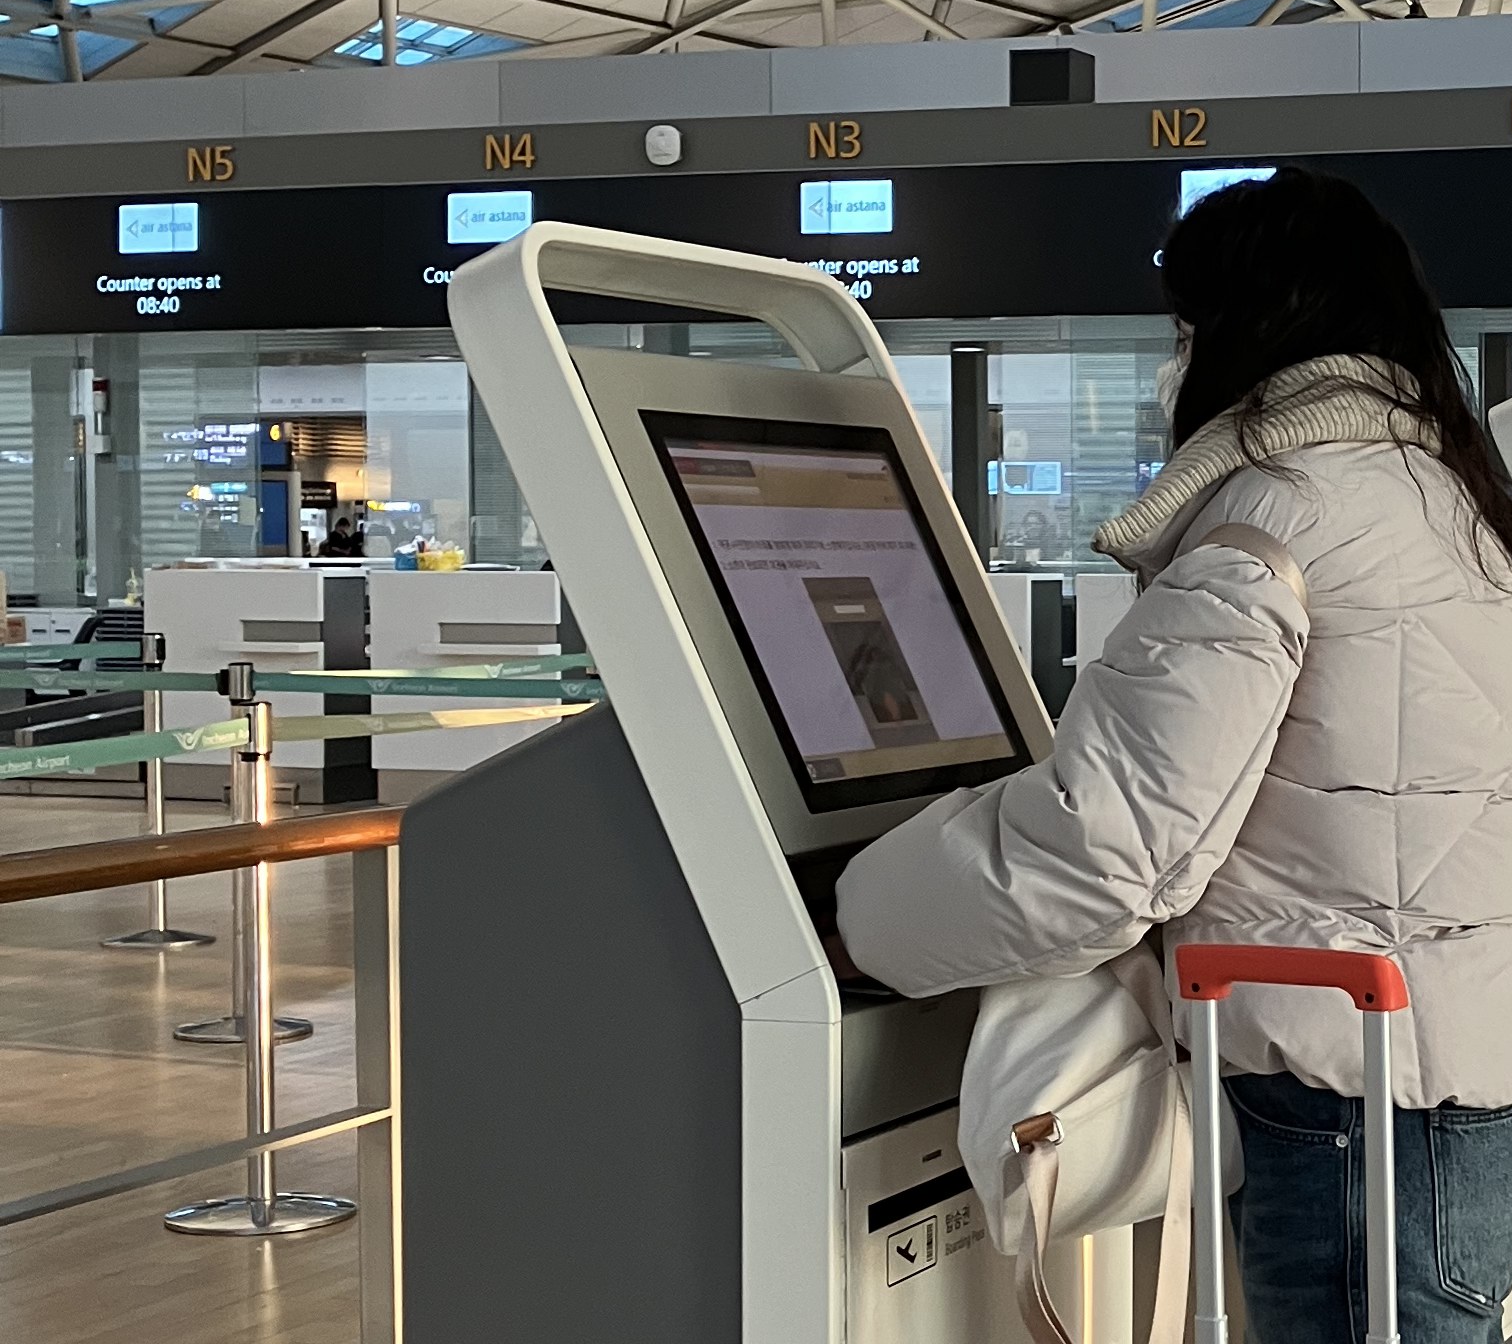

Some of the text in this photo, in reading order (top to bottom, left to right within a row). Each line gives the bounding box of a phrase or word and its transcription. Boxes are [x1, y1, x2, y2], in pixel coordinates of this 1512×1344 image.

[808, 120, 862, 159] N3
[1151, 109, 1207, 148] N2
[485, 132, 535, 171] N4
[187, 145, 235, 182] N5
[471, 211, 526, 223] air astana
[827, 200, 886, 213] air astana
[846, 258, 898, 278] opens
[902, 256, 920, 273] at
[96, 274, 221, 294] Counter opens at
[136, 295, 180, 314] 08:40
